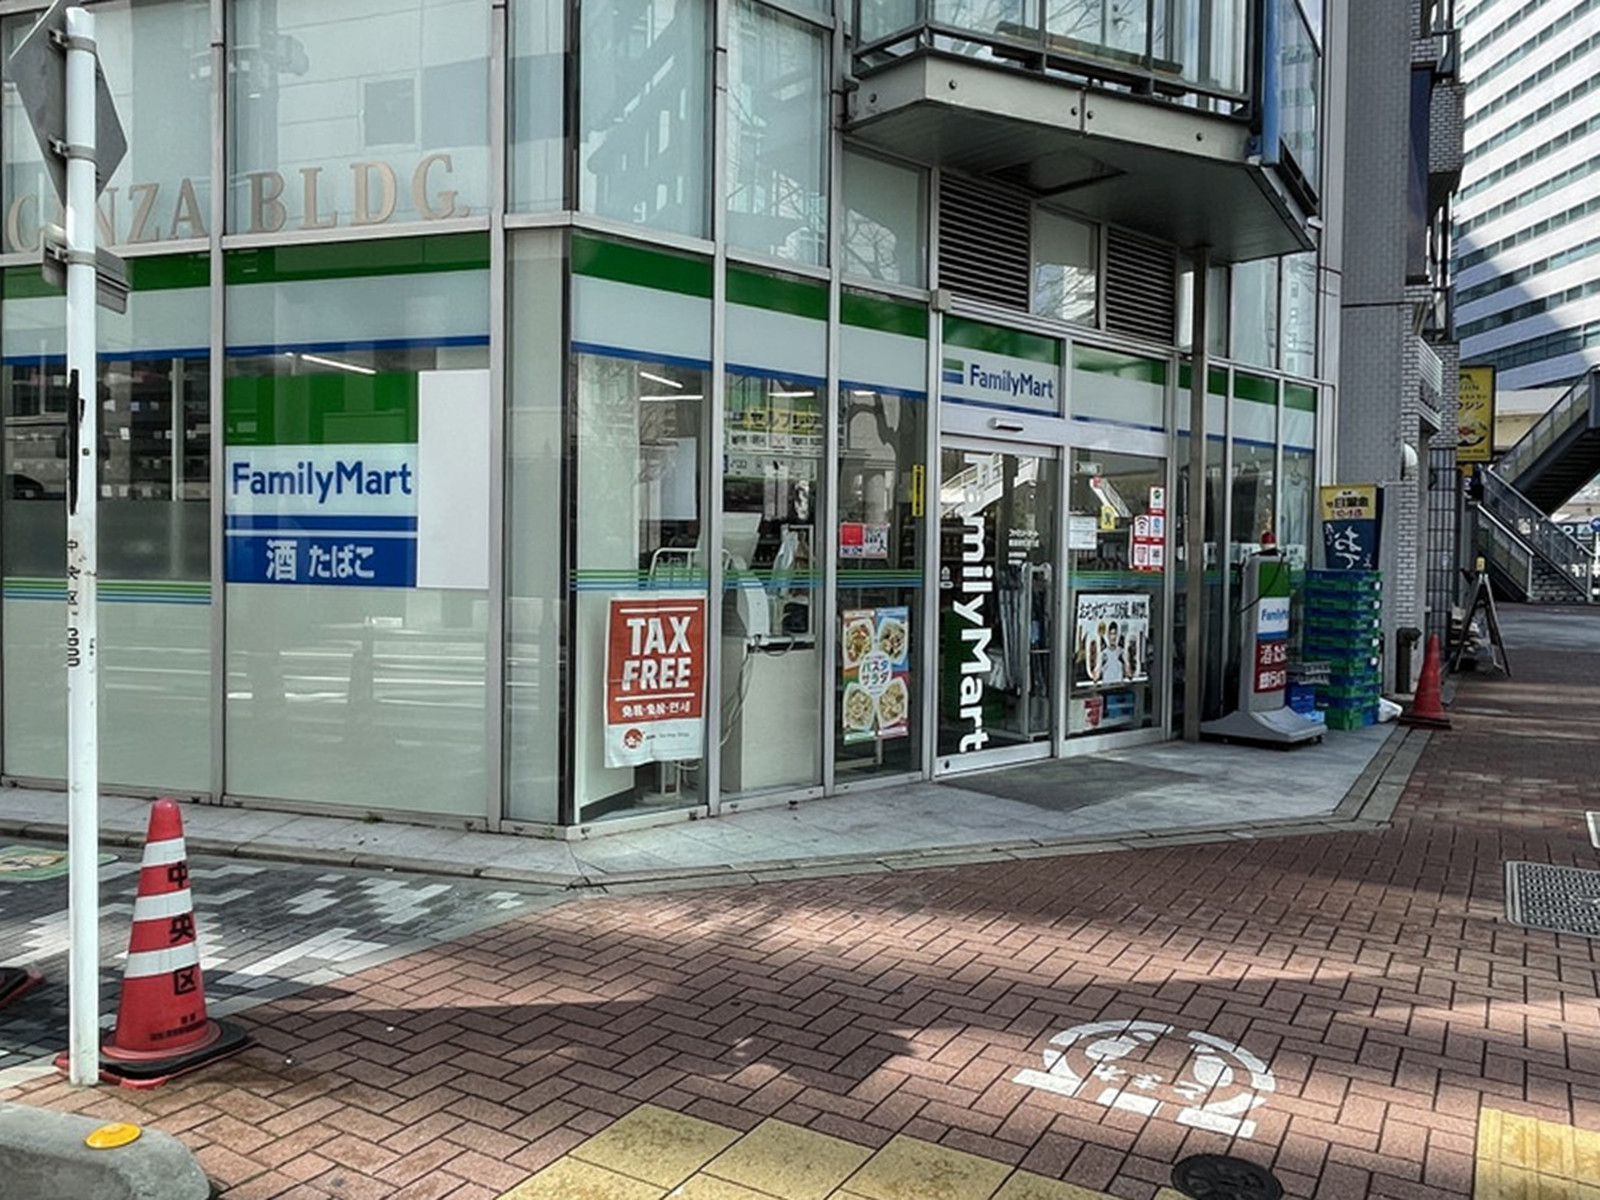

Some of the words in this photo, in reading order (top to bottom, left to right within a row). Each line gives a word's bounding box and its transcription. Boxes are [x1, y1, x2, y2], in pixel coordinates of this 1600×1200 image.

[247, 154, 470, 233] BLDG.
[970, 363, 1053, 399] FamilyMart
[232, 461, 412, 504] FamilyMart
[265, 539, 298, 581] 酒
[308, 544, 375, 579] たばこ
[953, 453, 993, 753] FamilyMart
[626, 616, 692, 656] TAX
[621, 657, 692, 691] FREE
[167, 861, 198, 995] 中央区
